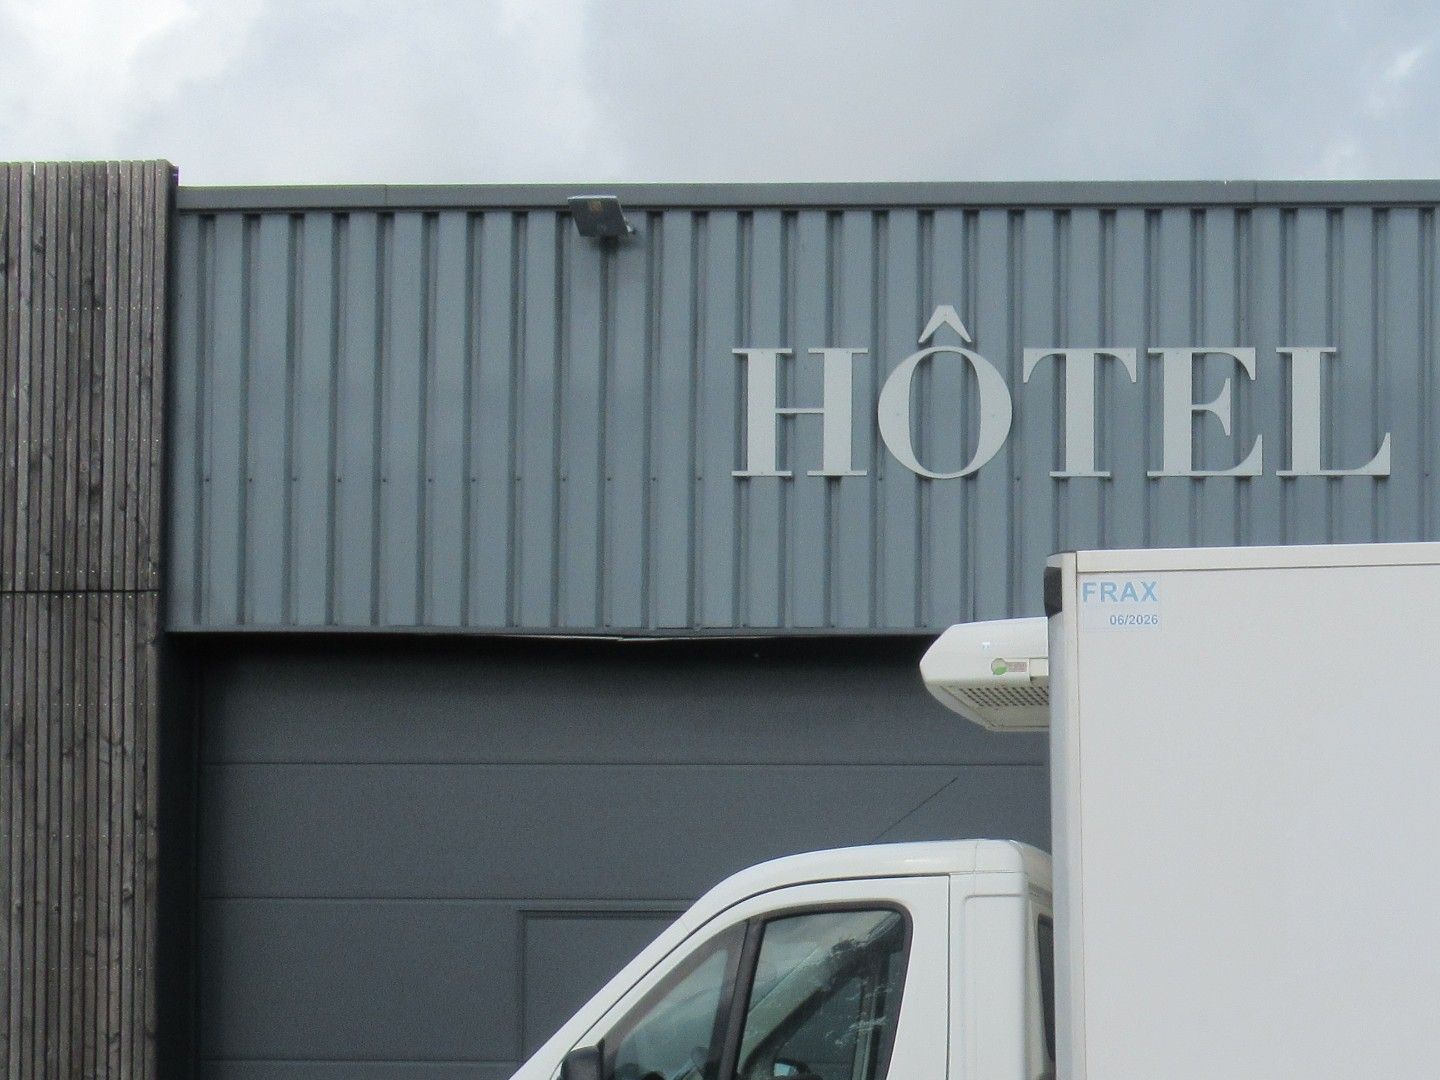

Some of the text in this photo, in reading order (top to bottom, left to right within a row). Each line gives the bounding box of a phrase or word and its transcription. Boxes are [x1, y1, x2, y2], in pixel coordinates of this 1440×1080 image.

[731, 304, 1392, 480] HÔTEL
[1082, 581, 1158, 602] FRAX
[1109, 614, 1158, 625] 06/2026
